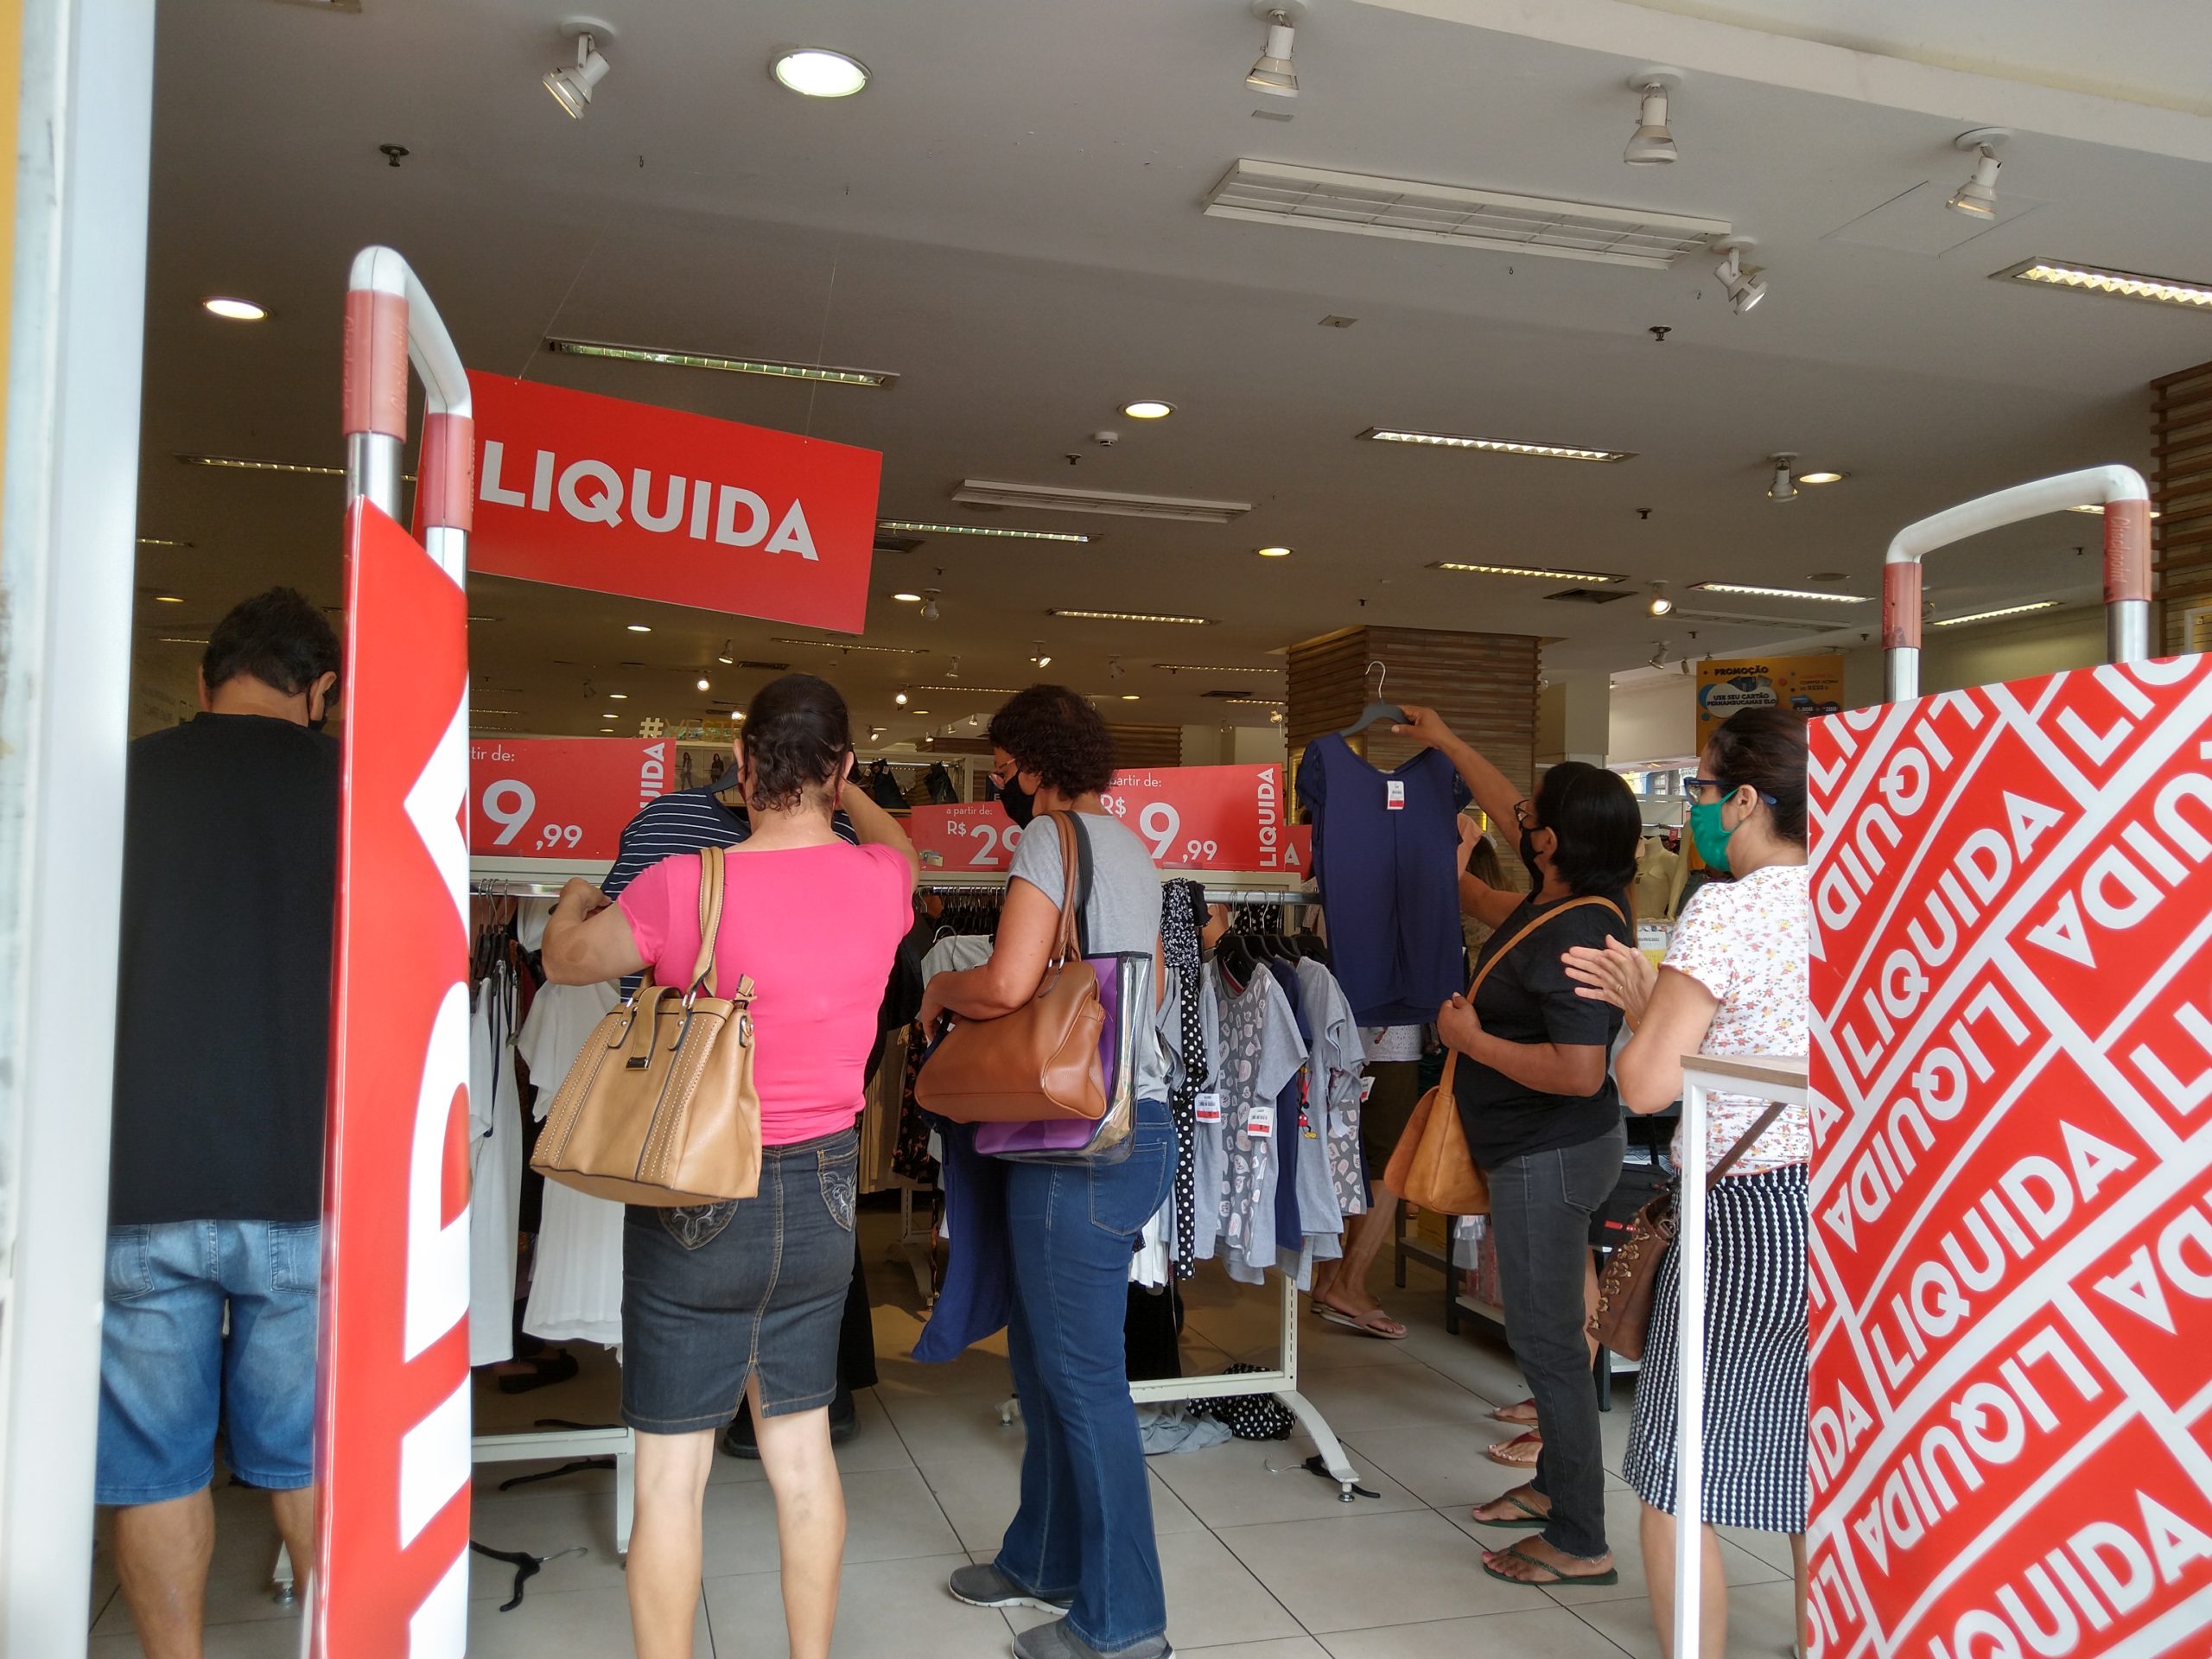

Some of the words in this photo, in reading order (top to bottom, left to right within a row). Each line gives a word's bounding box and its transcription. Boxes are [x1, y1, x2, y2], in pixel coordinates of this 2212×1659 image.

[480, 441, 819, 562] LIQUIDA
[1714, 664, 1769, 676] PROMOÇÃO
[491, 744, 515, 762] de:
[1143, 772, 1162, 788] de:
[947, 820, 967, 837] R$
[953, 805, 977, 817] partir
[979, 804, 993, 816] de:
[1256, 767, 1277, 867] LIQUIDA
[1841, 790, 2066, 1079] LIQUIDA
[1822, 982, 2031, 1253] LIQUIDA
[1870, 1119, 2139, 1390] LIQUIDA
[1853, 1325, 2103, 1577] LIQUIDA
